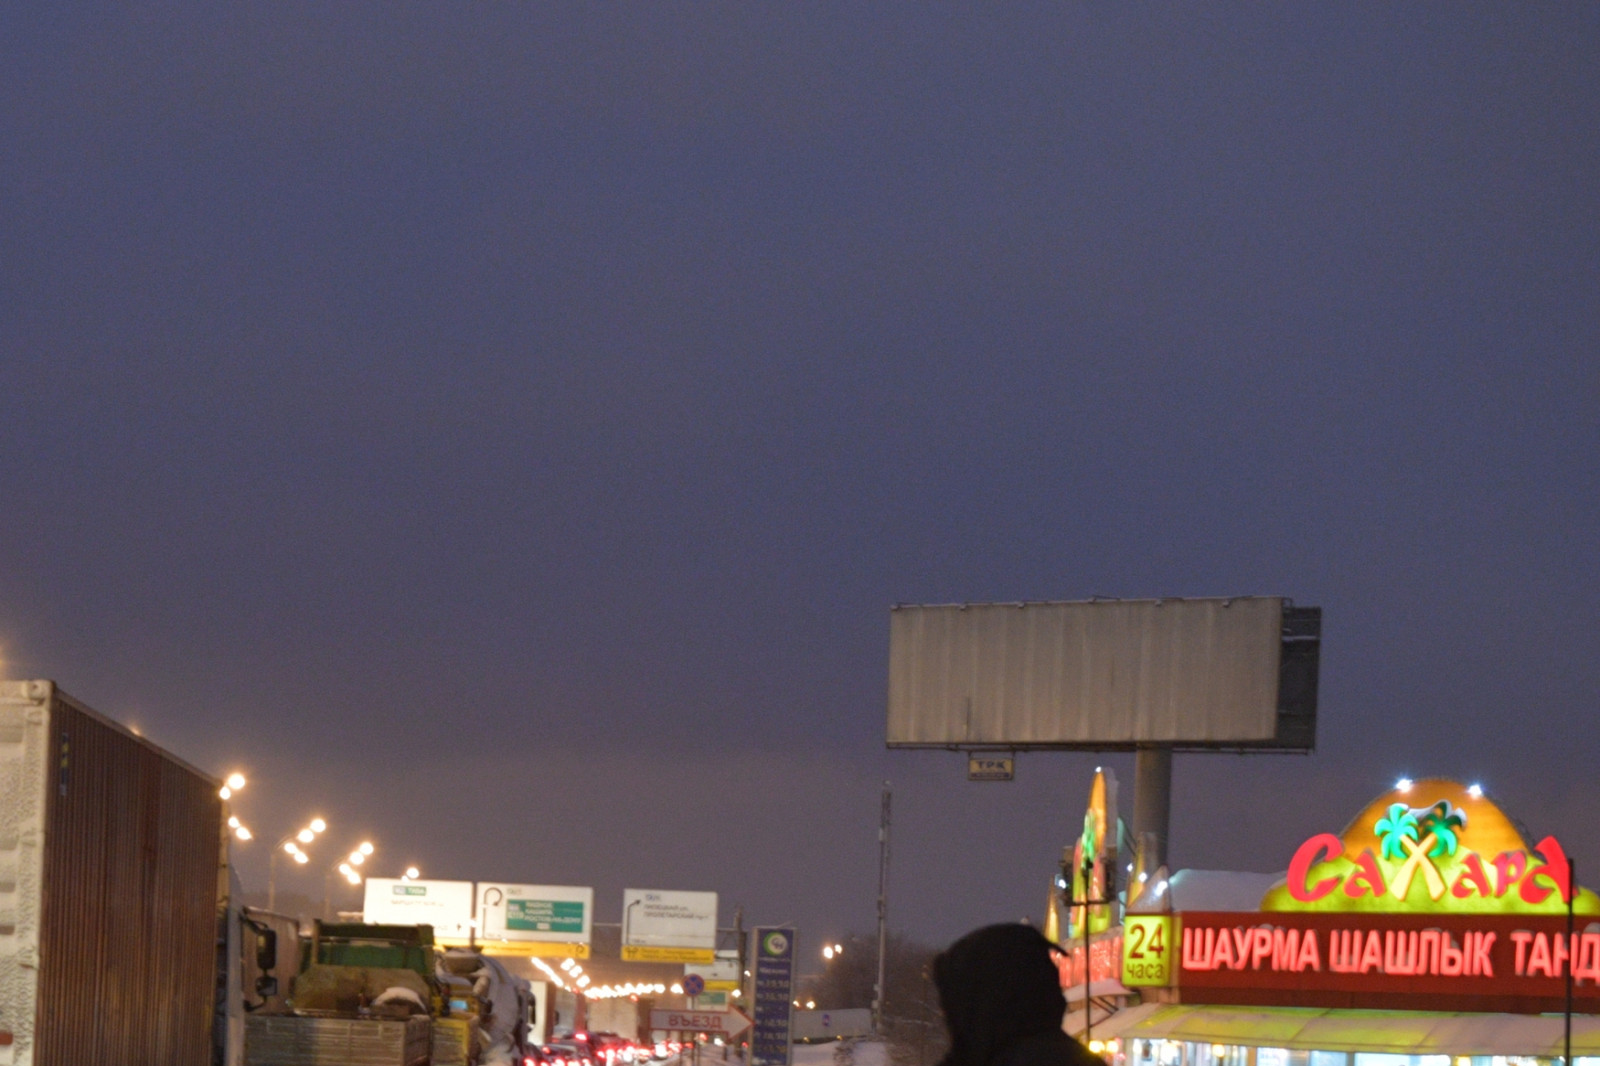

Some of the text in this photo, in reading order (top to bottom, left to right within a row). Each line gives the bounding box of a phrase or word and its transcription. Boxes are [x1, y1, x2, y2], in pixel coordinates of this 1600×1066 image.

[1129, 924, 1164, 959] 24
[1183, 927, 1320, 971] ШАУРМА
[1329, 929, 1497, 977] ШАШЛЫК
[1126, 963, 1164, 979] часа
[669, 1014, 723, 1029] ВЪЕЗД
